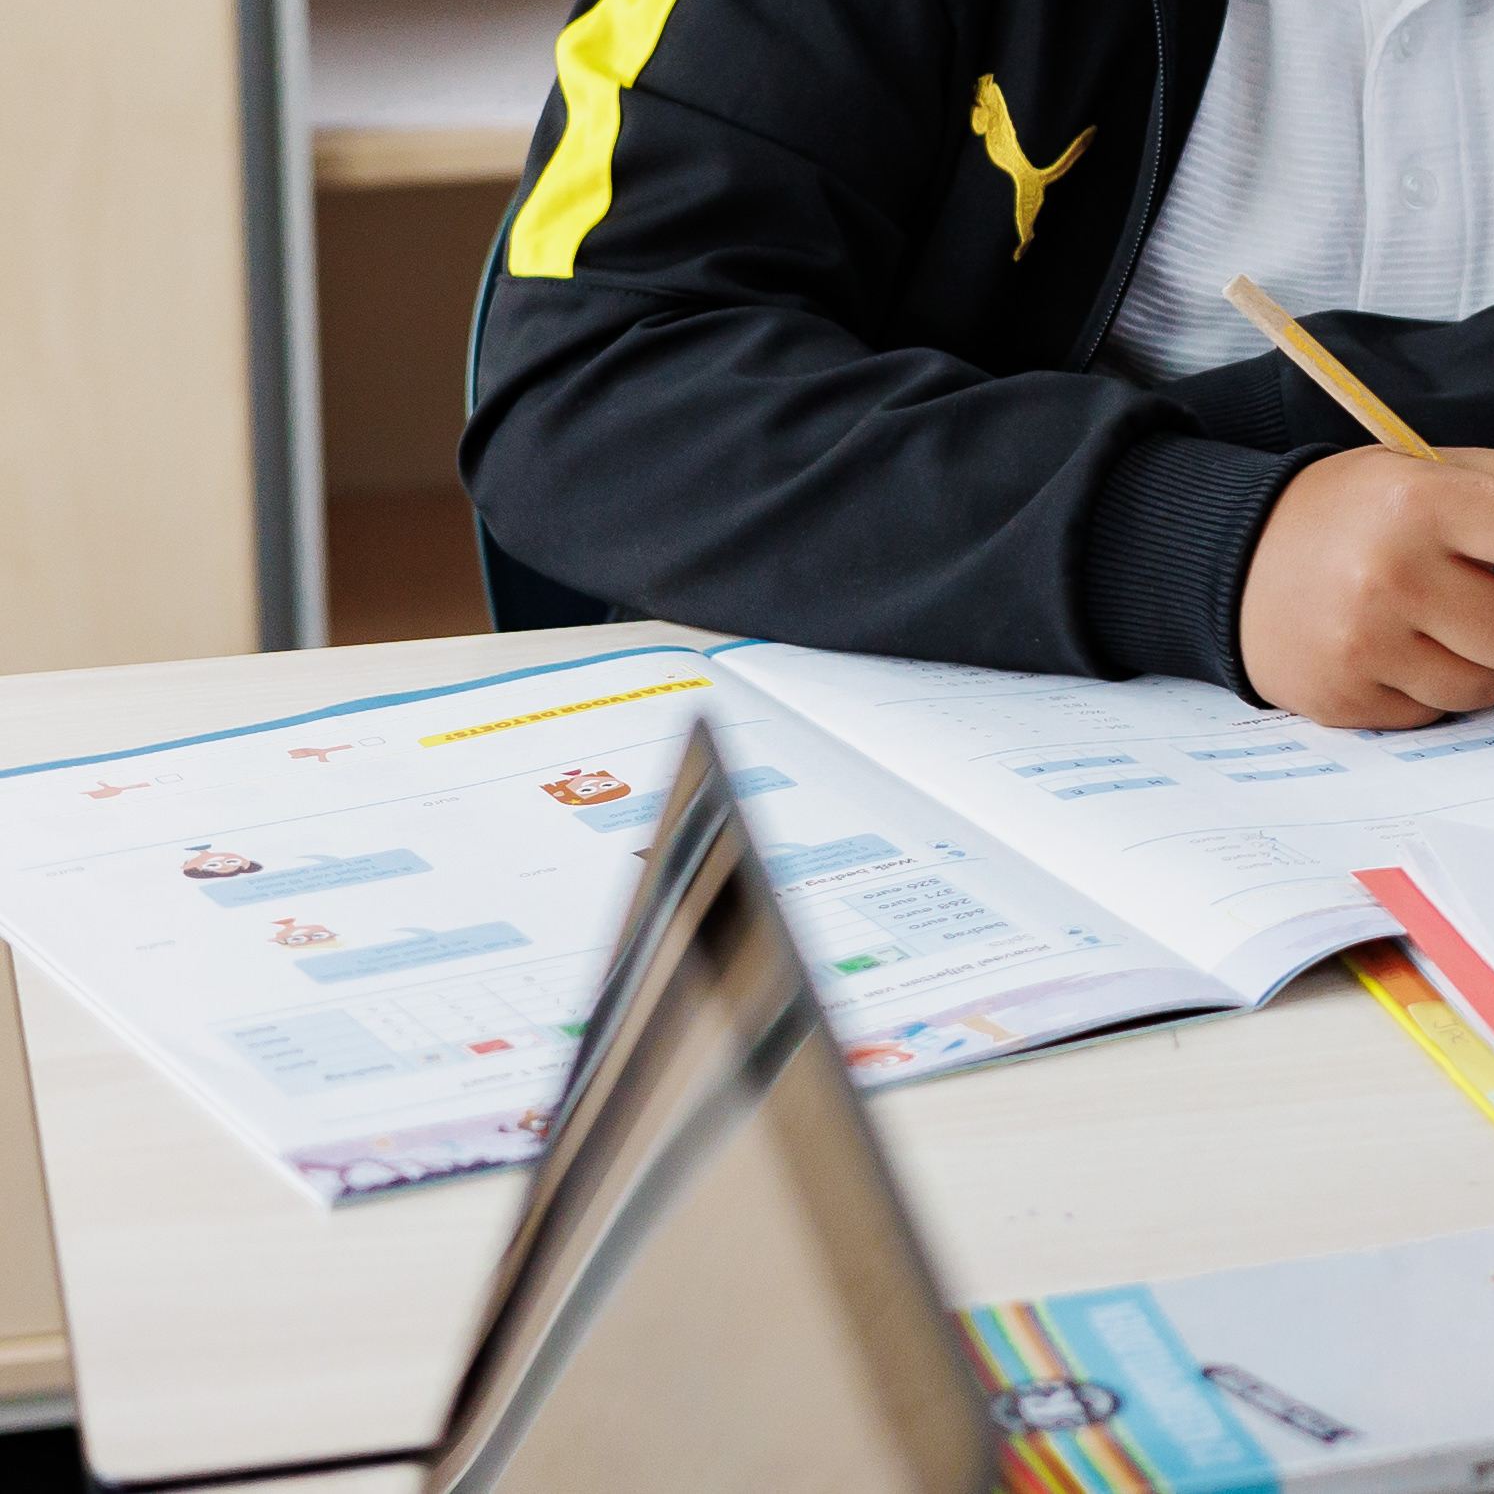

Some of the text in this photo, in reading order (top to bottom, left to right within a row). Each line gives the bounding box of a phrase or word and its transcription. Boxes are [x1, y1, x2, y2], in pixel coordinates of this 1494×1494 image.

[445, 679, 701, 741] KLAAR VOOR DE TOETS?
[805, 858, 919, 887] Welk bedrag
[862, 878, 941, 899] 526 euro
[877, 888, 957, 909] 371 euro
[893, 907, 933, 920] euro
[908, 907, 985, 931] 642 euro
[942, 921, 1009, 940] bedrag
[863, 943, 1052, 999] Hoeveel biljetten van
